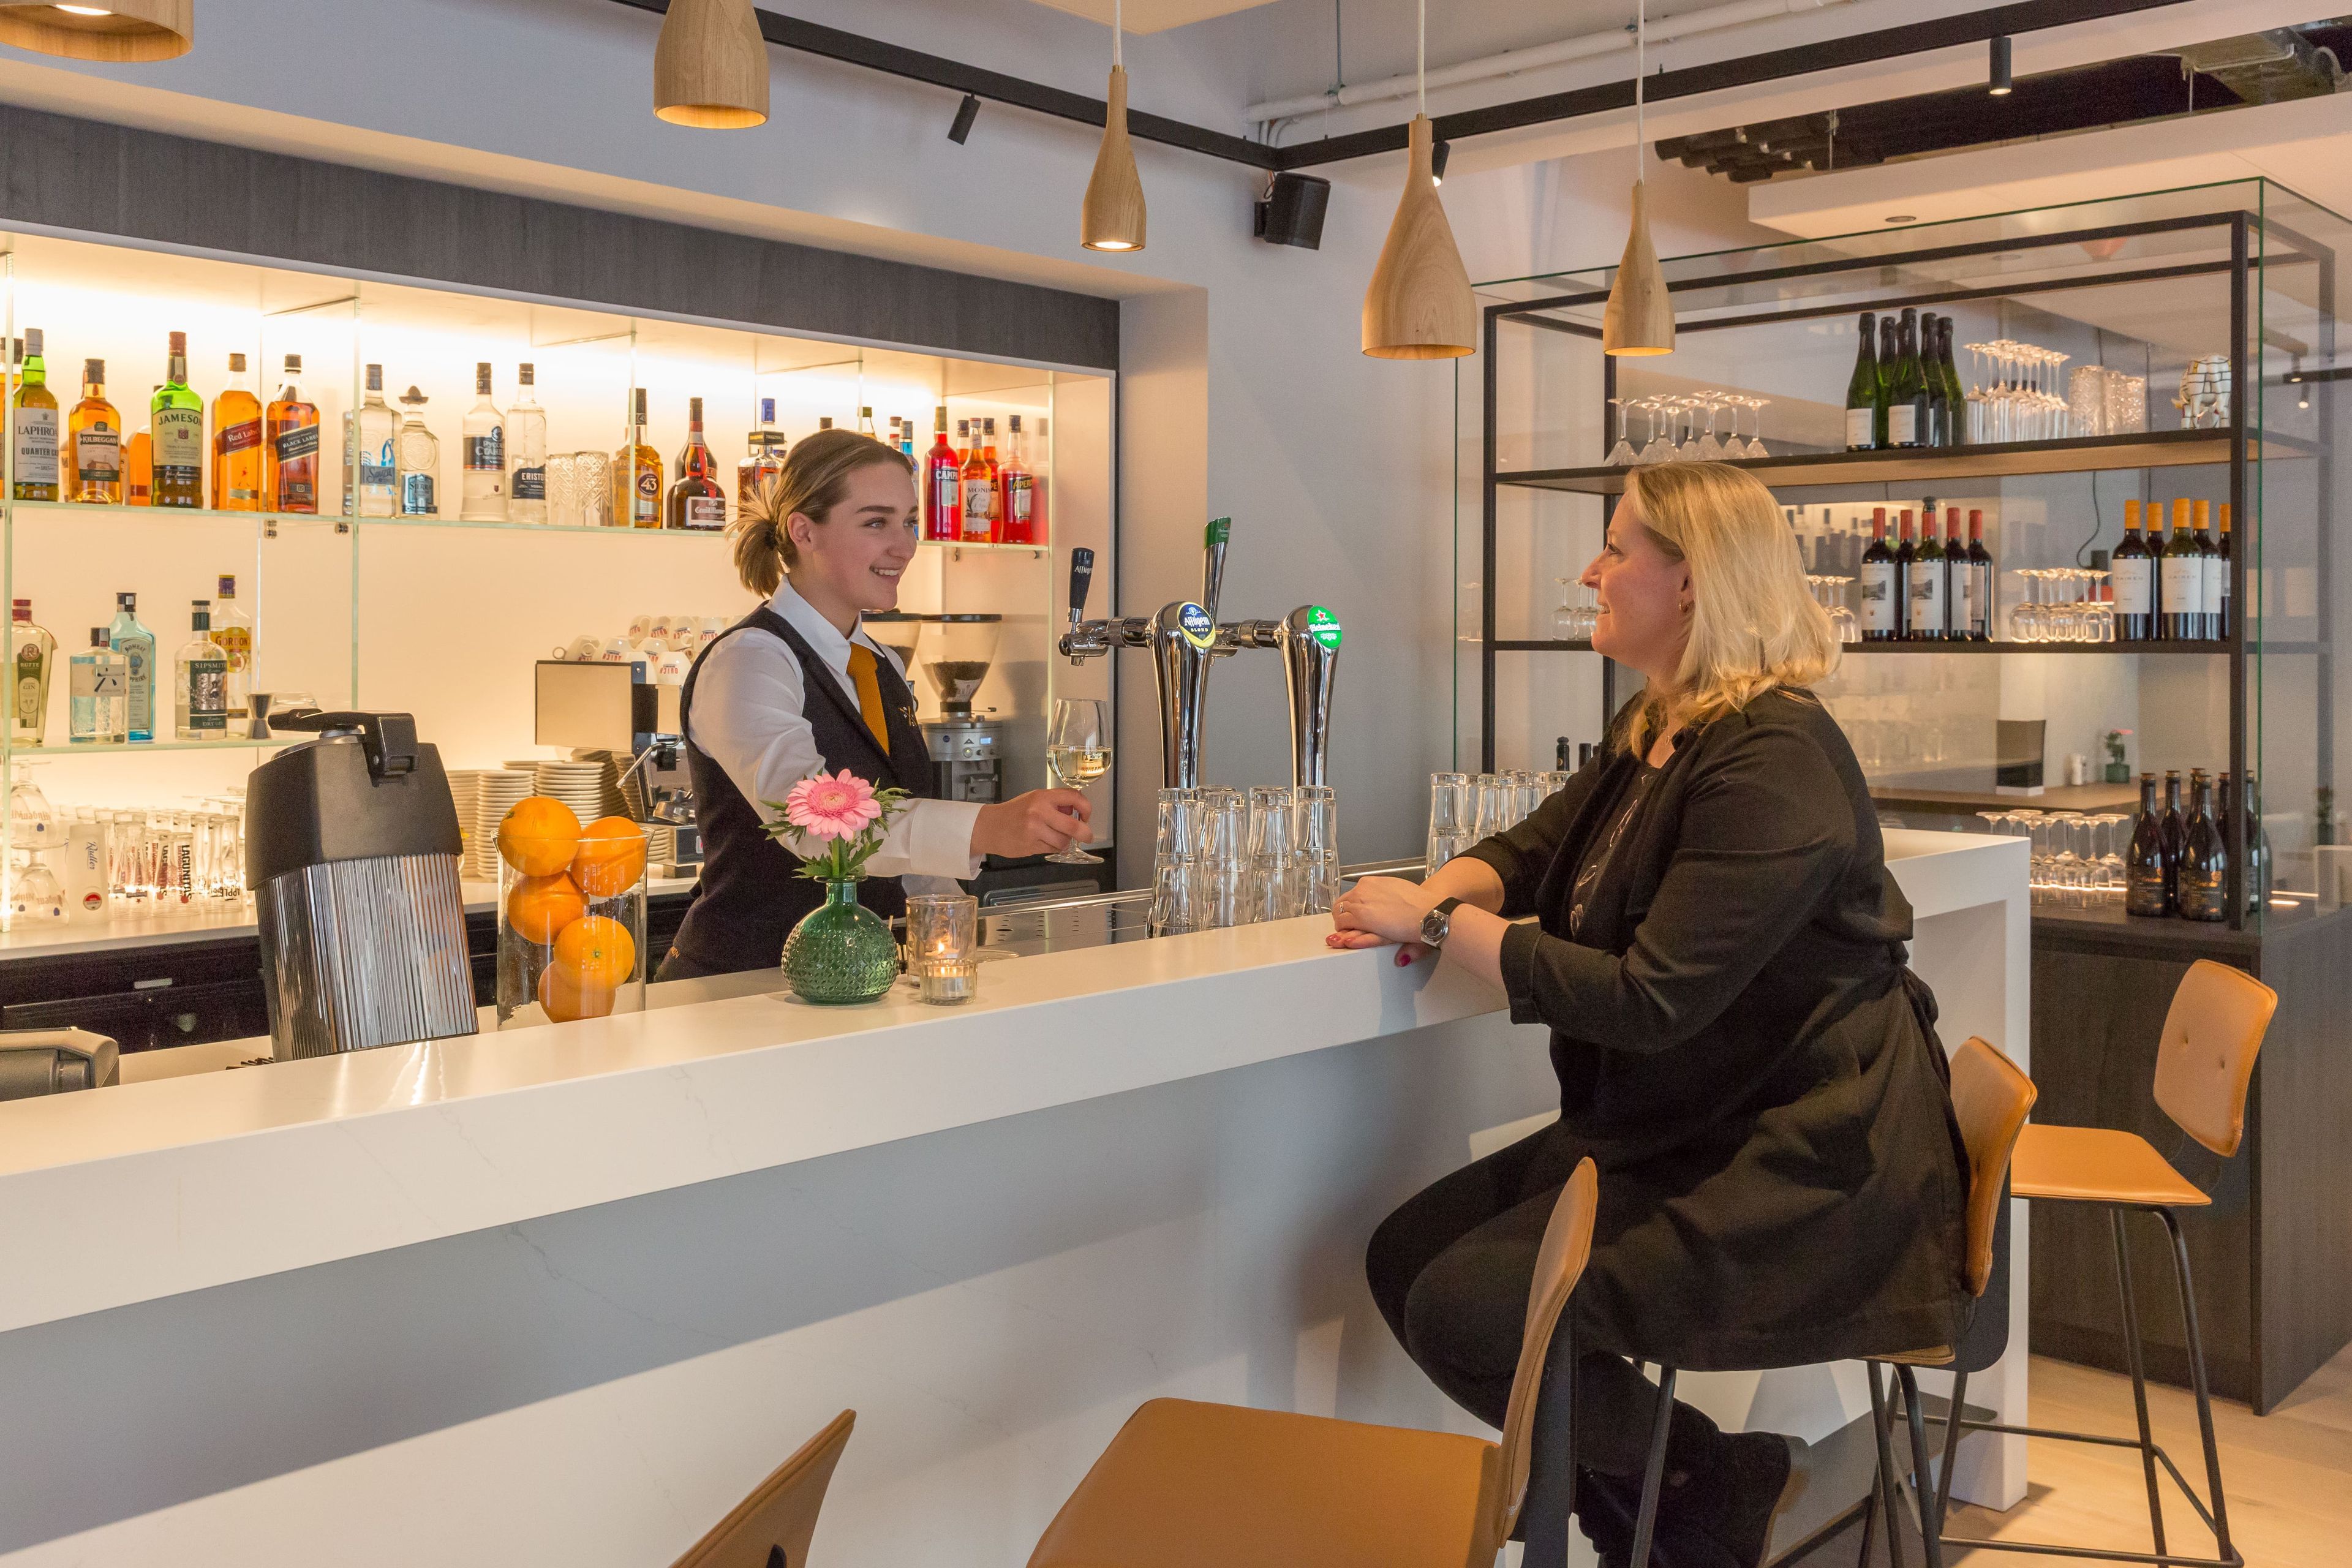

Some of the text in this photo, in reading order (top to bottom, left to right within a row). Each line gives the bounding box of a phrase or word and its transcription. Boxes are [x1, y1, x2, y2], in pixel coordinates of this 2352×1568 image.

[227, 432, 243, 442] Red
[282, 440, 301, 448] BLACK
[21, 447, 50, 456] QUARTER
[641, 478, 657, 491] 43
[1183, 616, 1210, 627] Affligem
[124, 644, 146, 653] BOMBAY
[85, 841, 99, 870] Radler
[182, 844, 192, 900] LAGUNITAS
